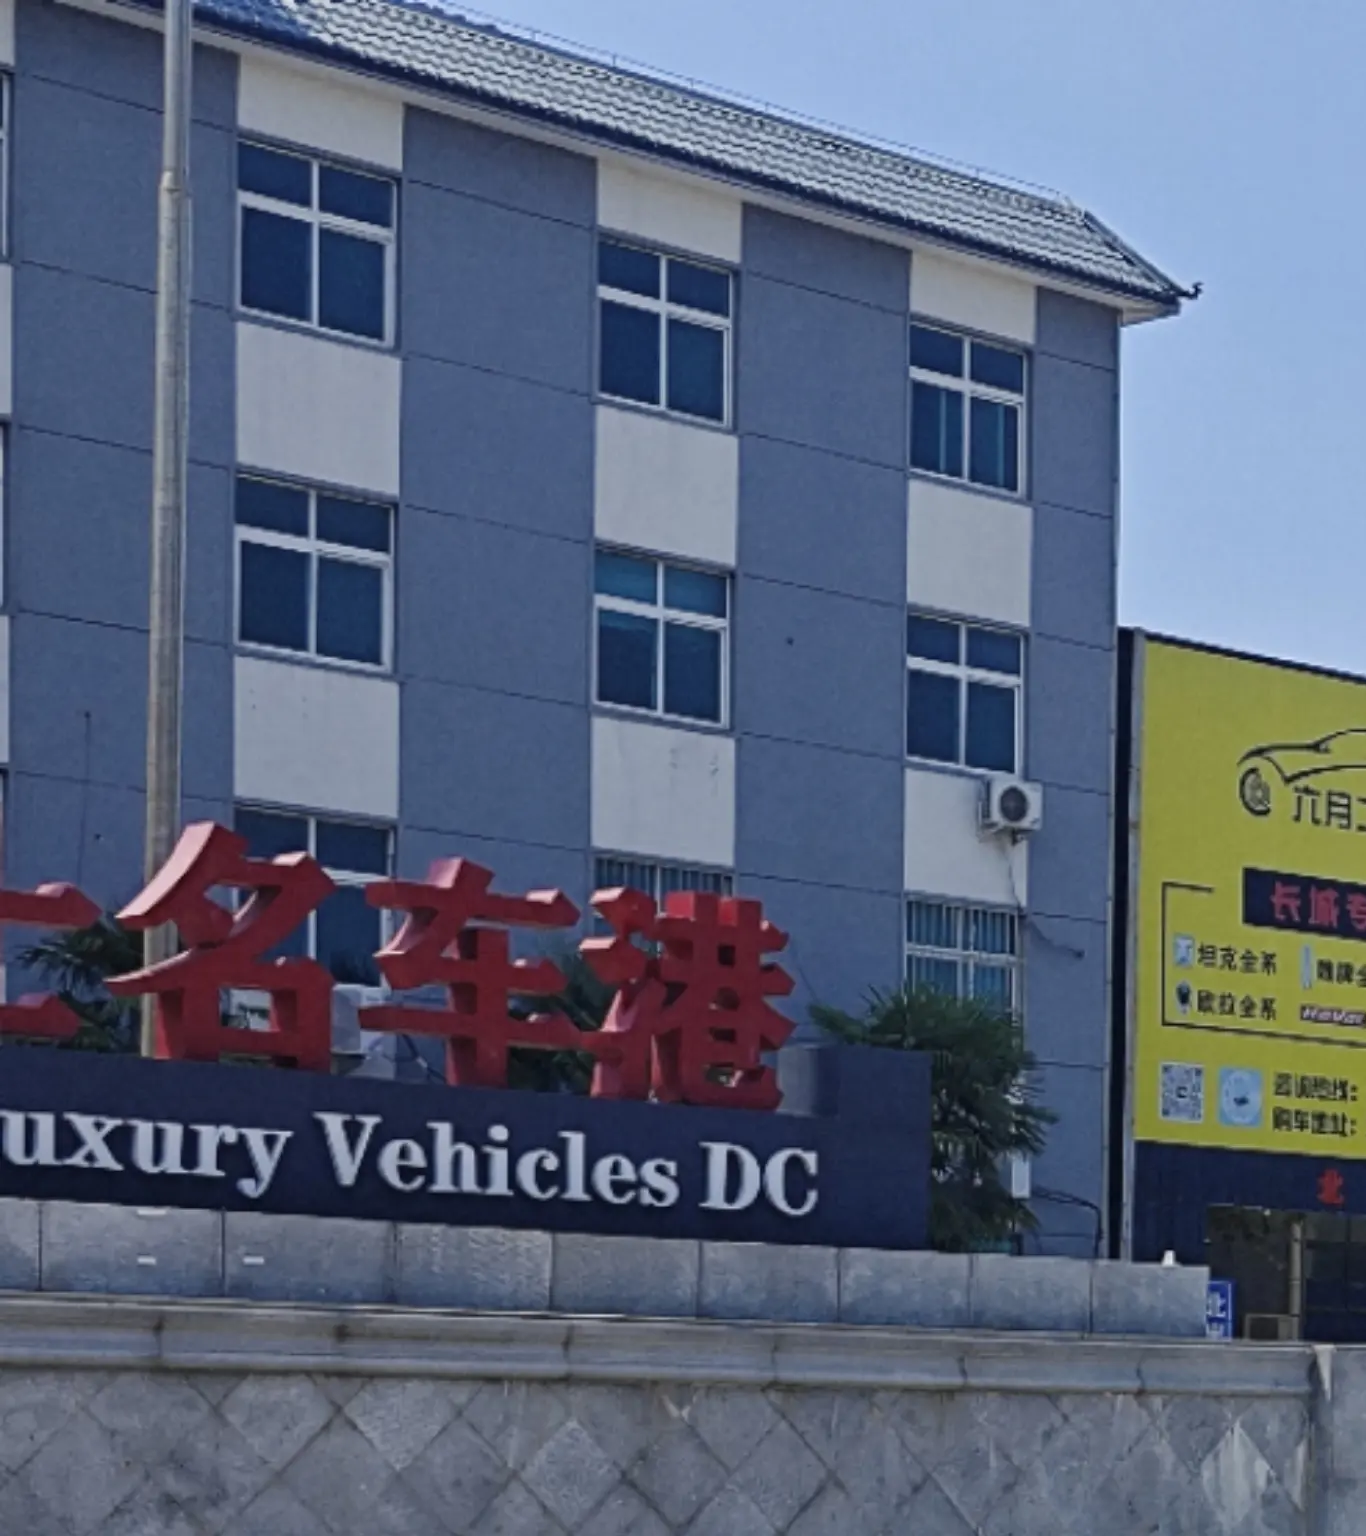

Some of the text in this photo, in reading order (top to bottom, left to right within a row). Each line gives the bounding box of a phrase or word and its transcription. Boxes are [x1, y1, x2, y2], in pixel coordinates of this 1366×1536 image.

[1197, 942, 1277, 976] 坦克全系
[1196, 989, 1277, 1021] 欧拉全系
[313, 1109, 681, 1209] Vehicles
[699, 1141, 820, 1216] DC
